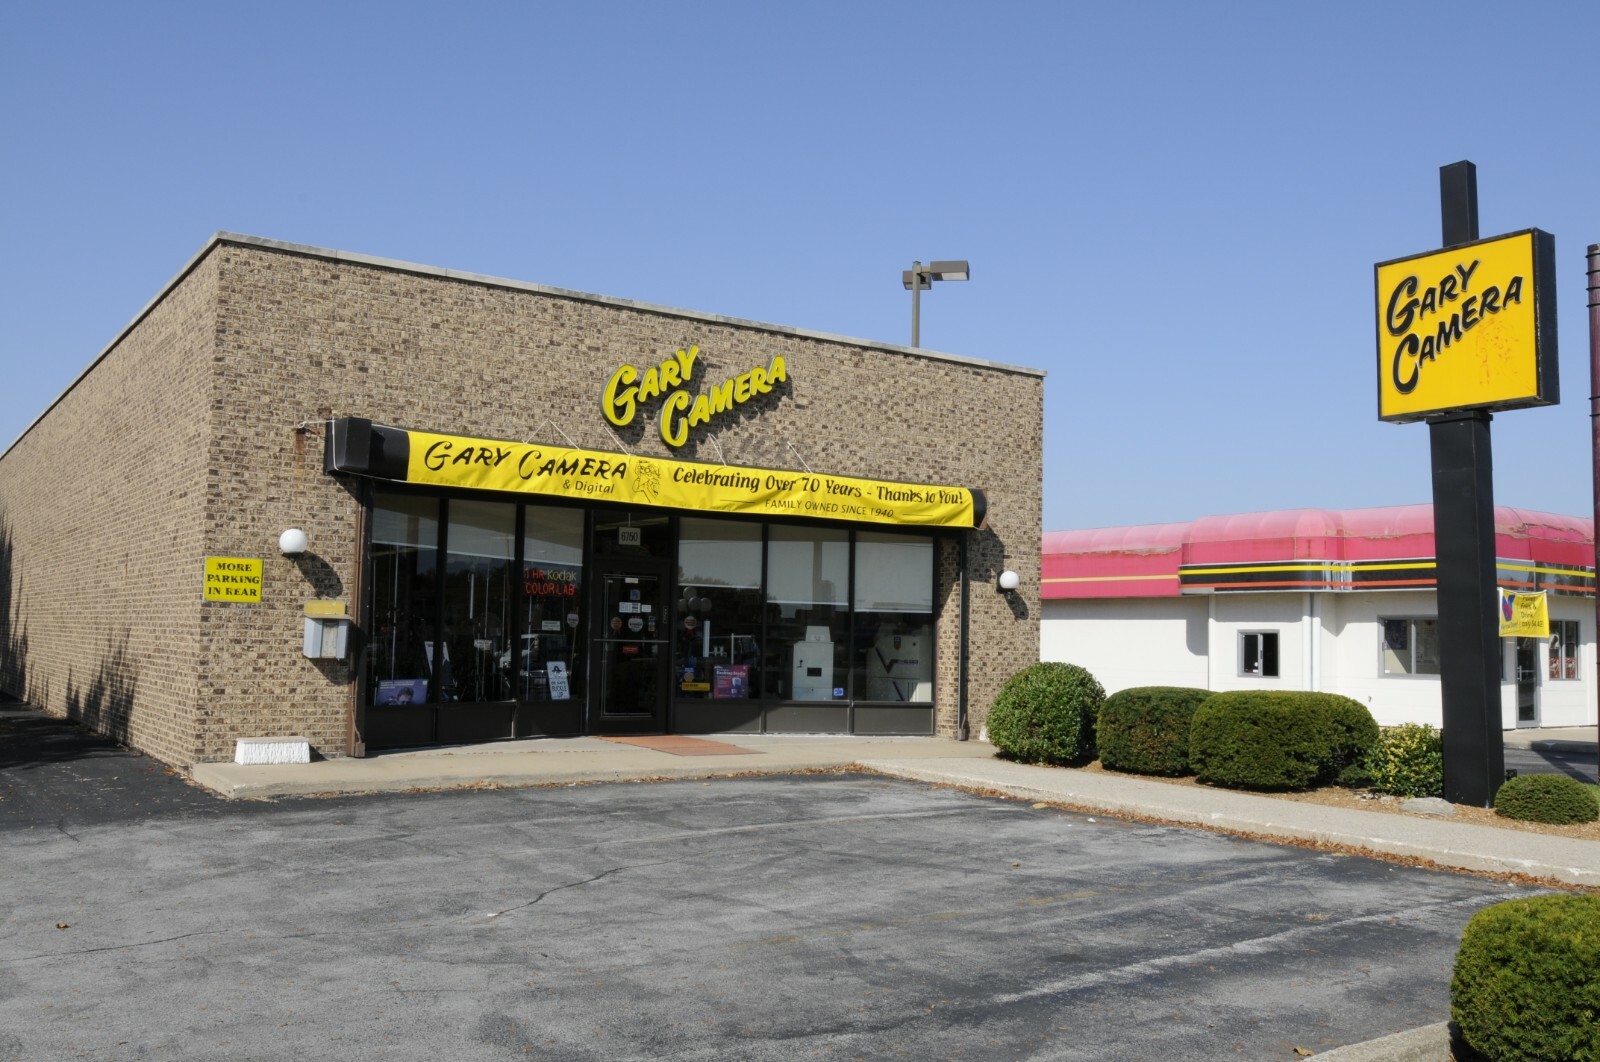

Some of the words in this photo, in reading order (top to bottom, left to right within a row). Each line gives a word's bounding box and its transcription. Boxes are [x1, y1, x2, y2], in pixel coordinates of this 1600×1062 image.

[1387, 260, 1480, 336] GARY
[1392, 276, 1523, 394] CAMERA
[600, 344, 699, 427] GARY
[658, 355, 787, 448] CAMERA
[424, 440, 511, 471] GARY
[518, 449, 627, 480] CAMERA
[562, 480, 570, 489] &
[575, 481, 614, 494] Digital
[673, 466, 760, 492] Celebrating
[765, 474, 796, 492] Over
[802, 477, 820, 492] 70
[826, 479, 862, 498] Years
[877, 485, 923, 503] Thanks
[925, 492, 936, 504] to
[939, 489, 963, 505] You!
[765, 498, 802, 510] FAMILY
[805, 501, 838, 513] OWNED
[841, 504, 867, 516] SINCE
[870, 507, 894, 518] 1940
[621, 531, 639, 542] 6750
[216, 562, 252, 572] MORE
[532, 569, 545, 580] HR
[547, 569, 577, 581] Kodak
[207, 574, 260, 584] PARKING
[208, 587, 221, 596] IN
[226, 587, 258, 597] REAR
[525, 582, 555, 595] COLOR
[557, 583, 575, 596] LAB
